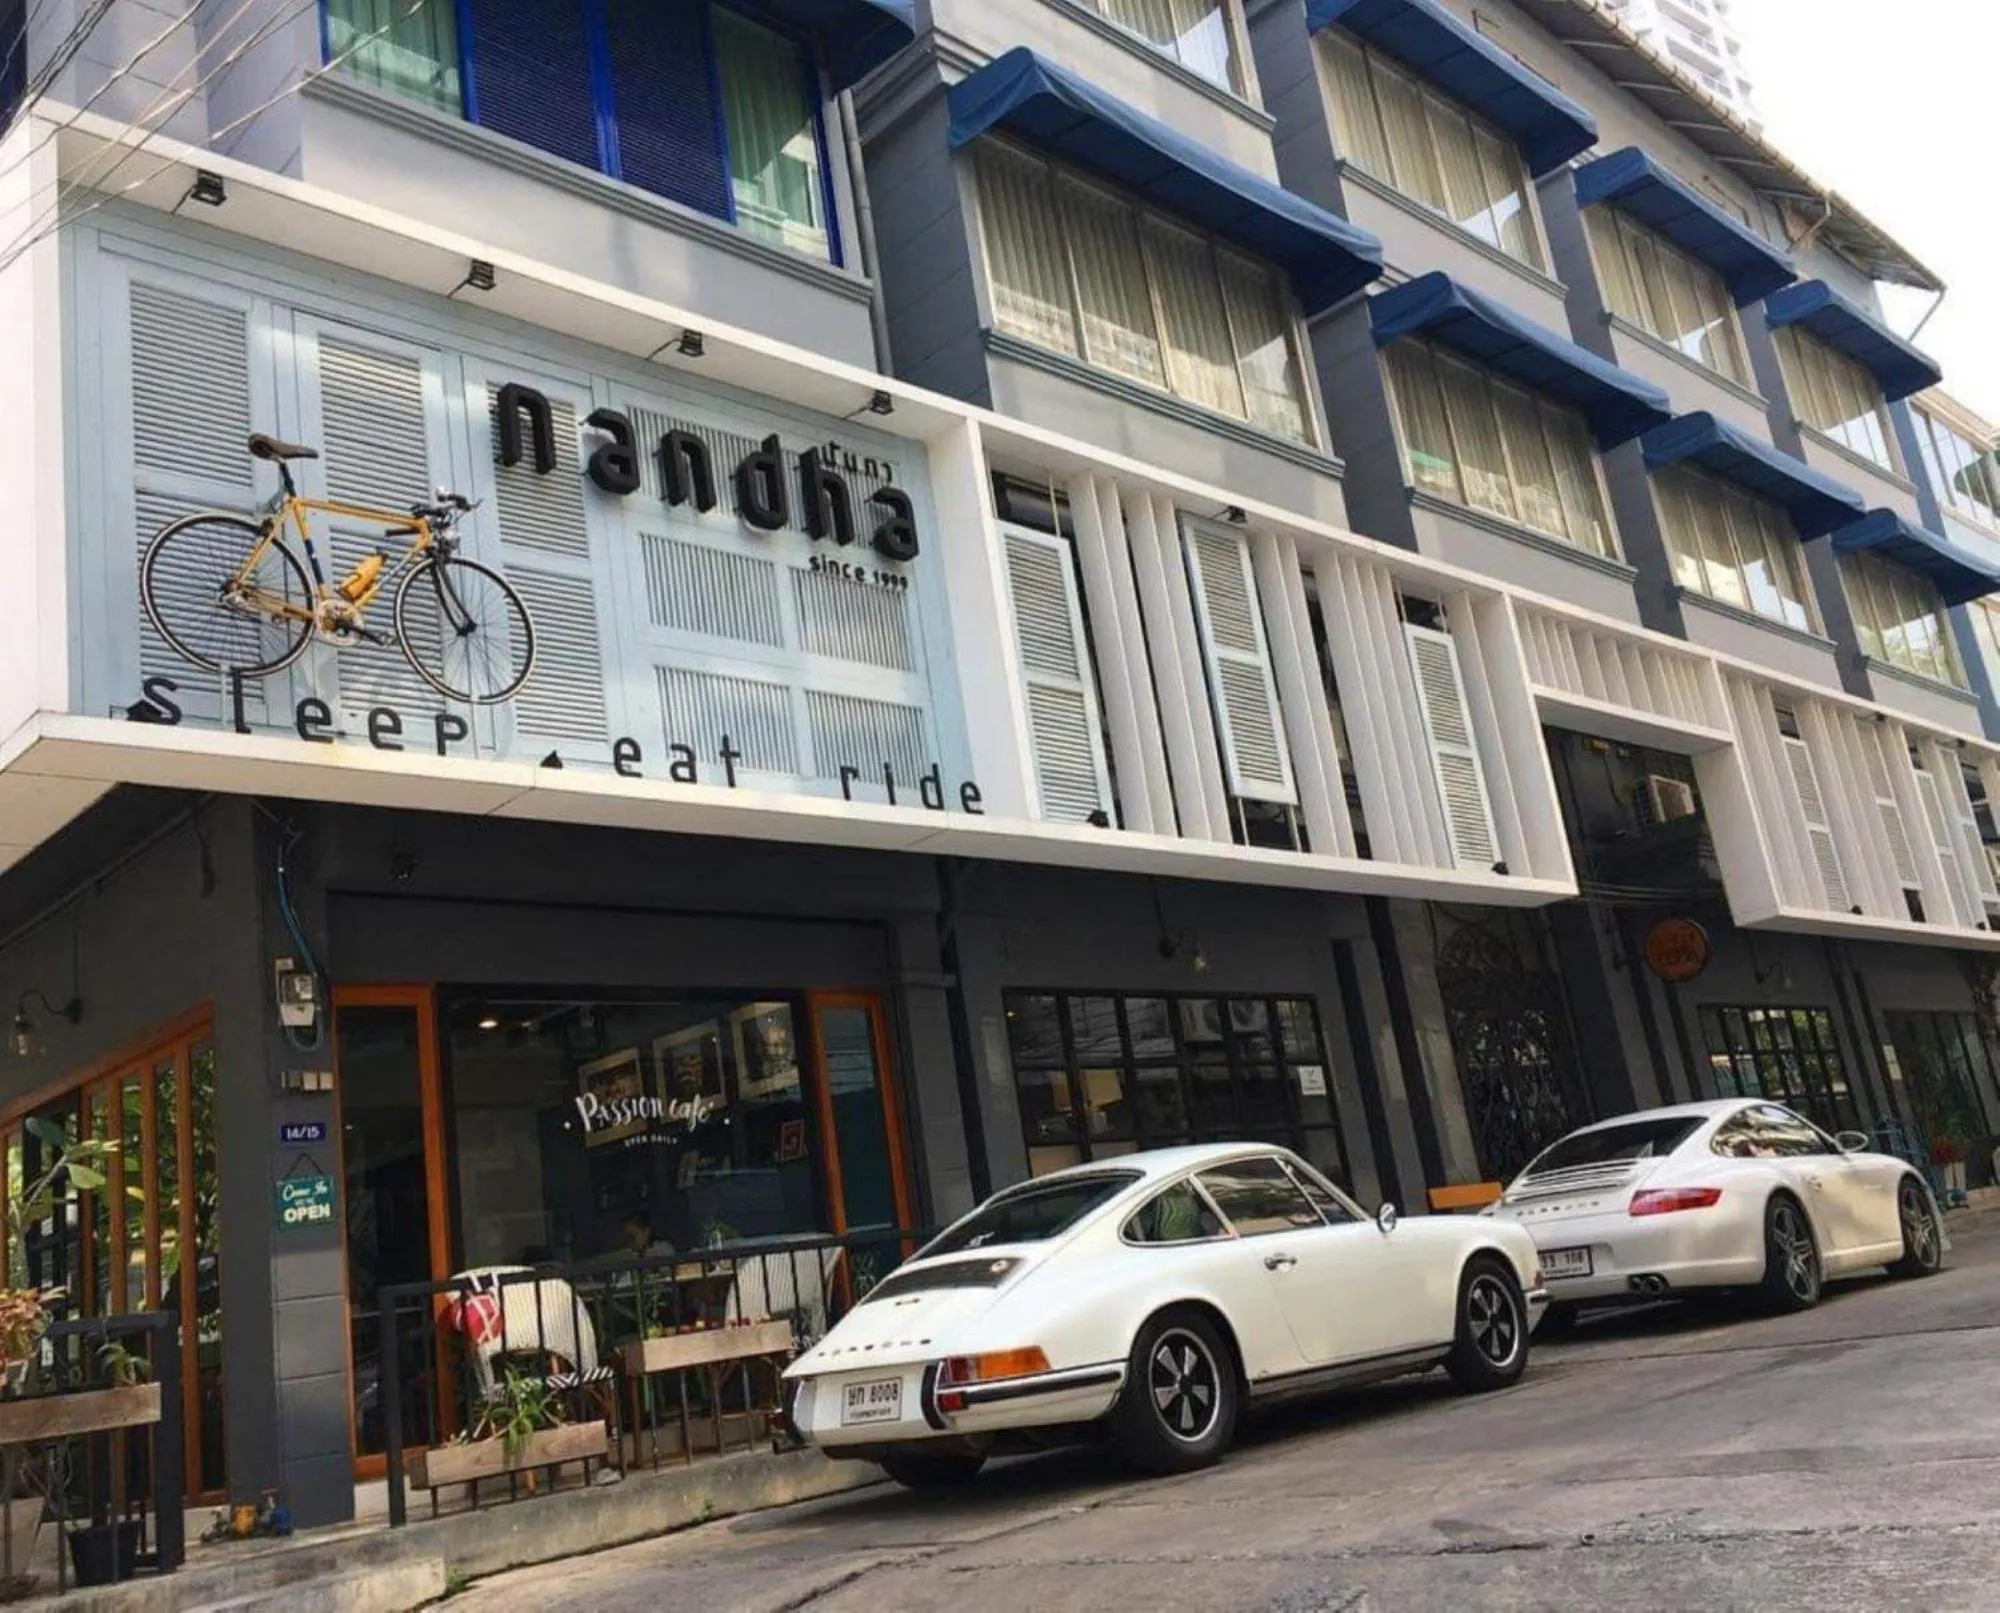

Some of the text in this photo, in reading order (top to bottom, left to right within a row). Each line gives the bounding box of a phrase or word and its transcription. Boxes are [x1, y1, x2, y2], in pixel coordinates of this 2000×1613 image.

[497, 381, 921, 562] nandha
[808, 553, 867, 583] since
[140, 666, 985, 816] sleep eat ride
[286, 1125, 320, 1139] 14/15
[283, 1203, 331, 1223] OPEN
